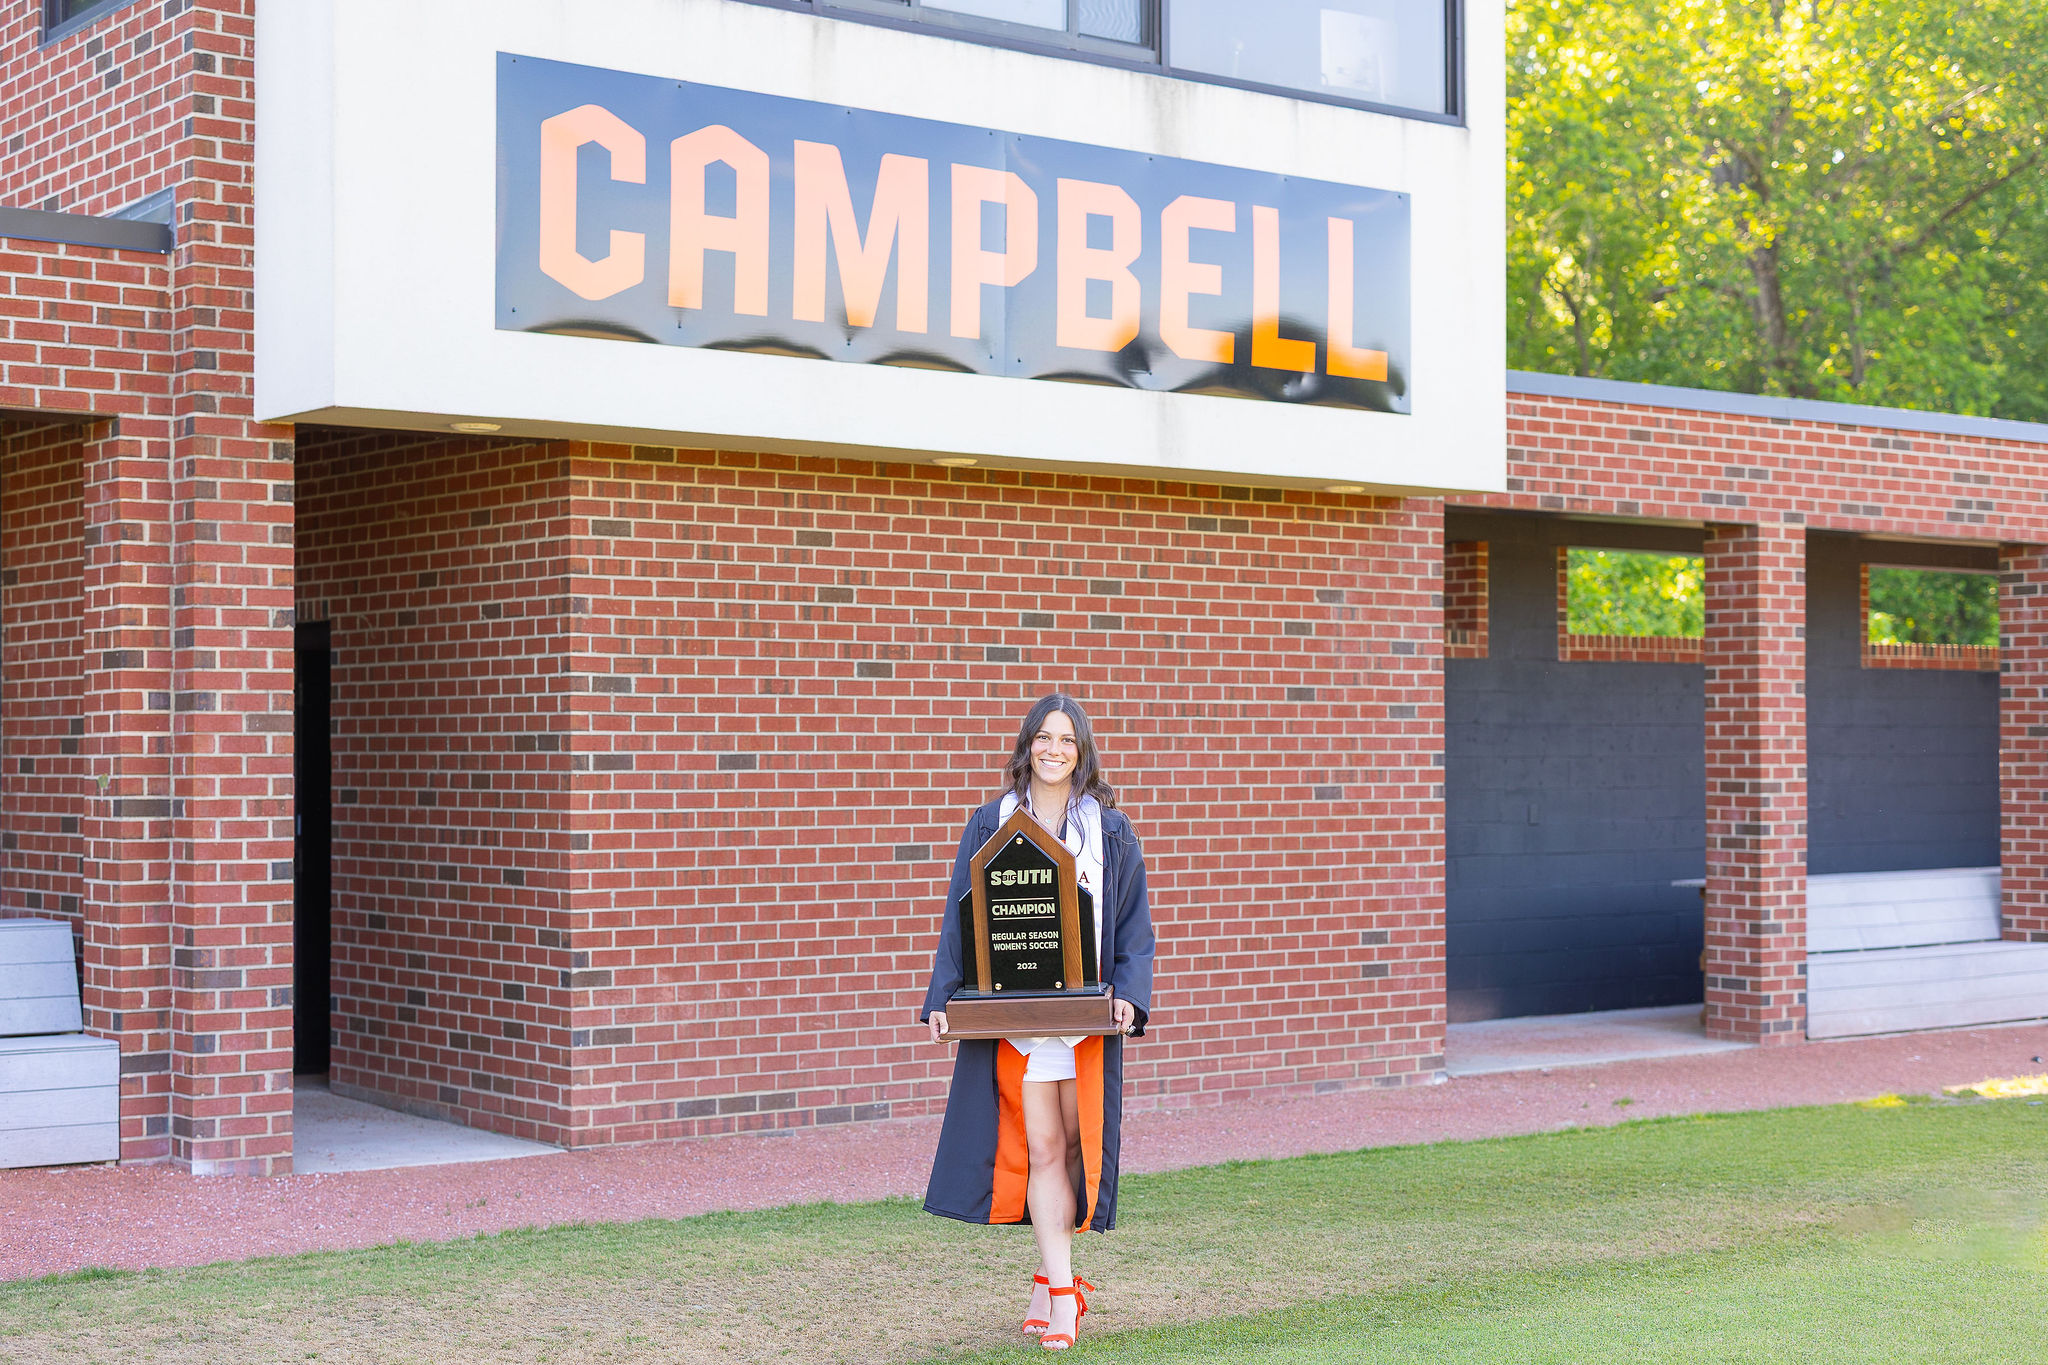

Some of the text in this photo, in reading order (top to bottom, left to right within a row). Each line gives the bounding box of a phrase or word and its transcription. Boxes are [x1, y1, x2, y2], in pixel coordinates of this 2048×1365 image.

[540, 104, 1388, 382] CAMPBELL
[990, 868, 1053, 886] SOUTH
[991, 902, 1056, 916] CHAMPION
[991, 930, 1059, 941] REGULAR SEASON
[993, 941, 1059, 951] WOMEN'S SOCCER
[1016, 962, 1038, 970] 2022
